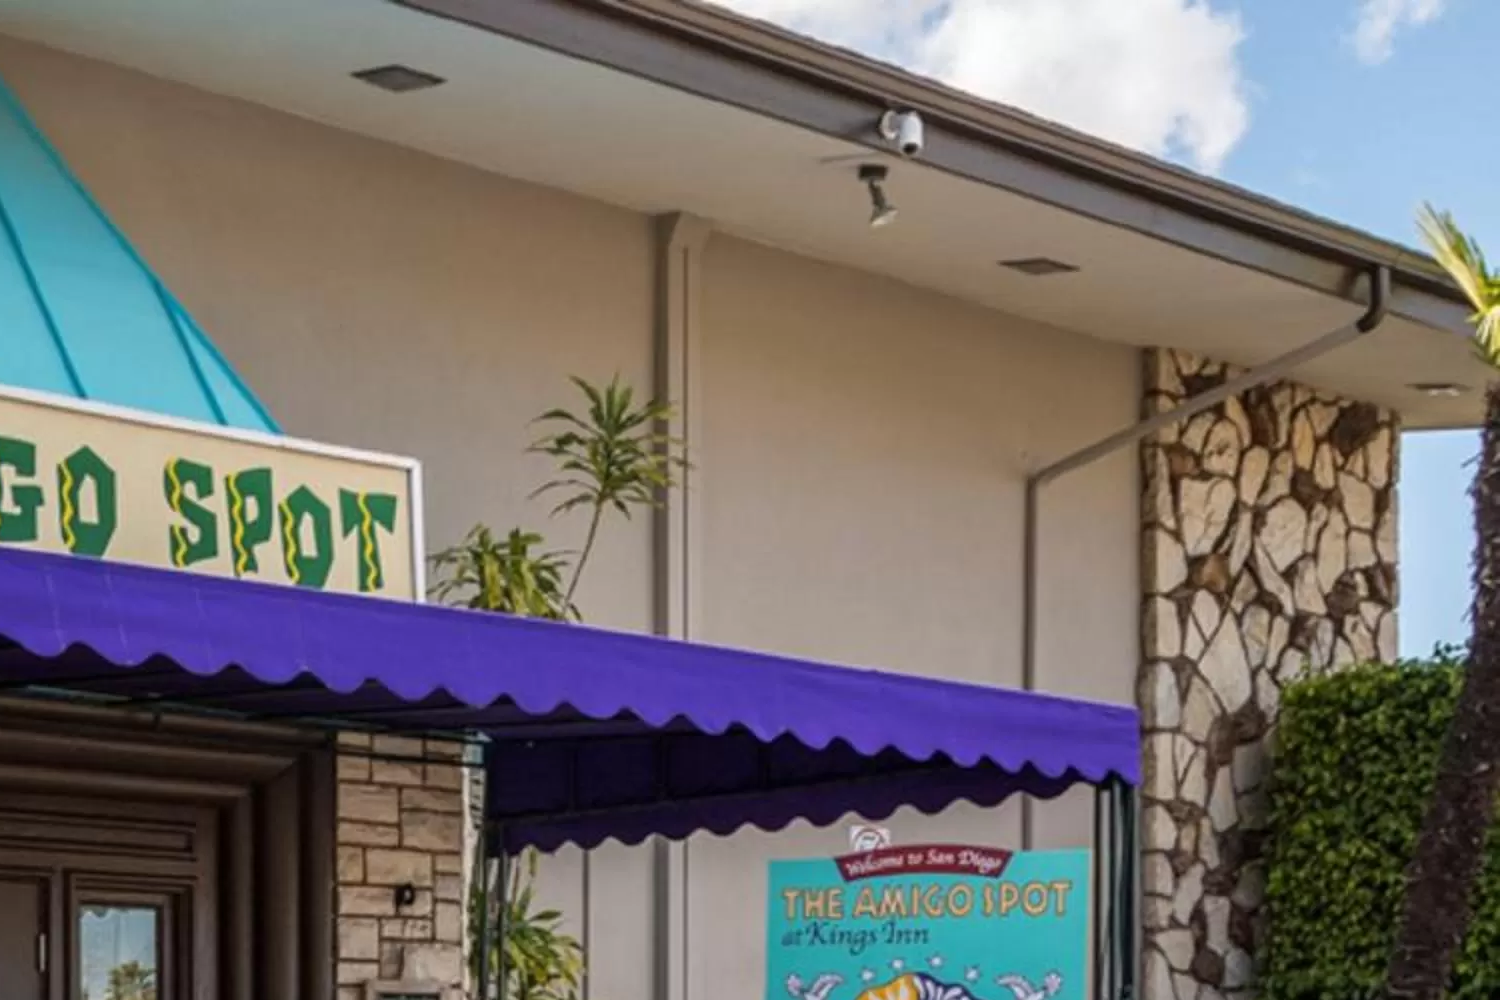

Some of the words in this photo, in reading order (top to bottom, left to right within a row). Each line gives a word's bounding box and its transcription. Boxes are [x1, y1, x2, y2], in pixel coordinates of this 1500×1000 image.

[164, 456, 397, 592] SPOT
[907, 851, 924, 865] to
[926, 848, 955, 865] San
[958, 849, 1002, 874] Diego
[782, 887, 844, 920] THE
[852, 882, 973, 919] AMIGO
[982, 880, 1072, 917] SPOT
[781, 927, 805, 946] at
[805, 922, 878, 956] Kings
[881, 919, 930, 945] Inn
